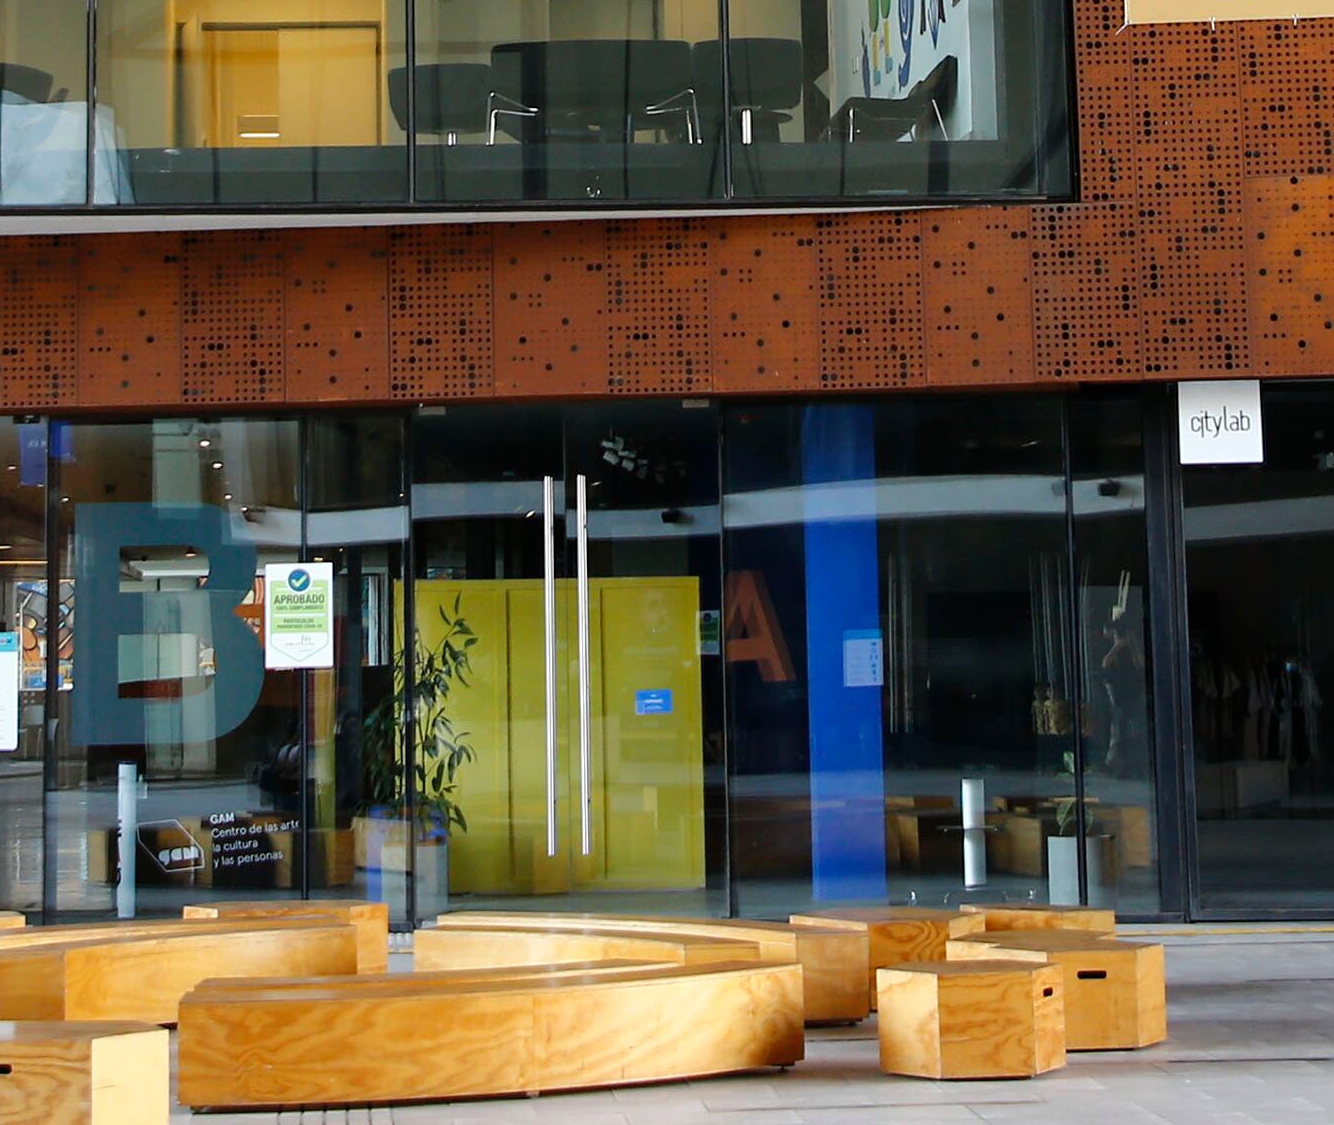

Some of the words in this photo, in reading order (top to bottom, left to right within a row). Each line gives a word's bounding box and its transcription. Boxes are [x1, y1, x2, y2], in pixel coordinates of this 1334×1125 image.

[1190, 405, 1251, 438] citylab
[274, 594, 325, 604] APROBADO
[72, 502, 266, 746] B
[725, 569, 797, 682] A
[210, 812, 235, 824] GAM
[210, 824, 247, 839] Centro
[249, 821, 262, 834] de
[264, 820, 278, 832] las
[213, 843, 221, 853] la
[223, 840, 259, 852] cultura
[213, 859, 219, 869] y
[221, 855, 235, 866] las
[237, 851, 284, 866] personas
